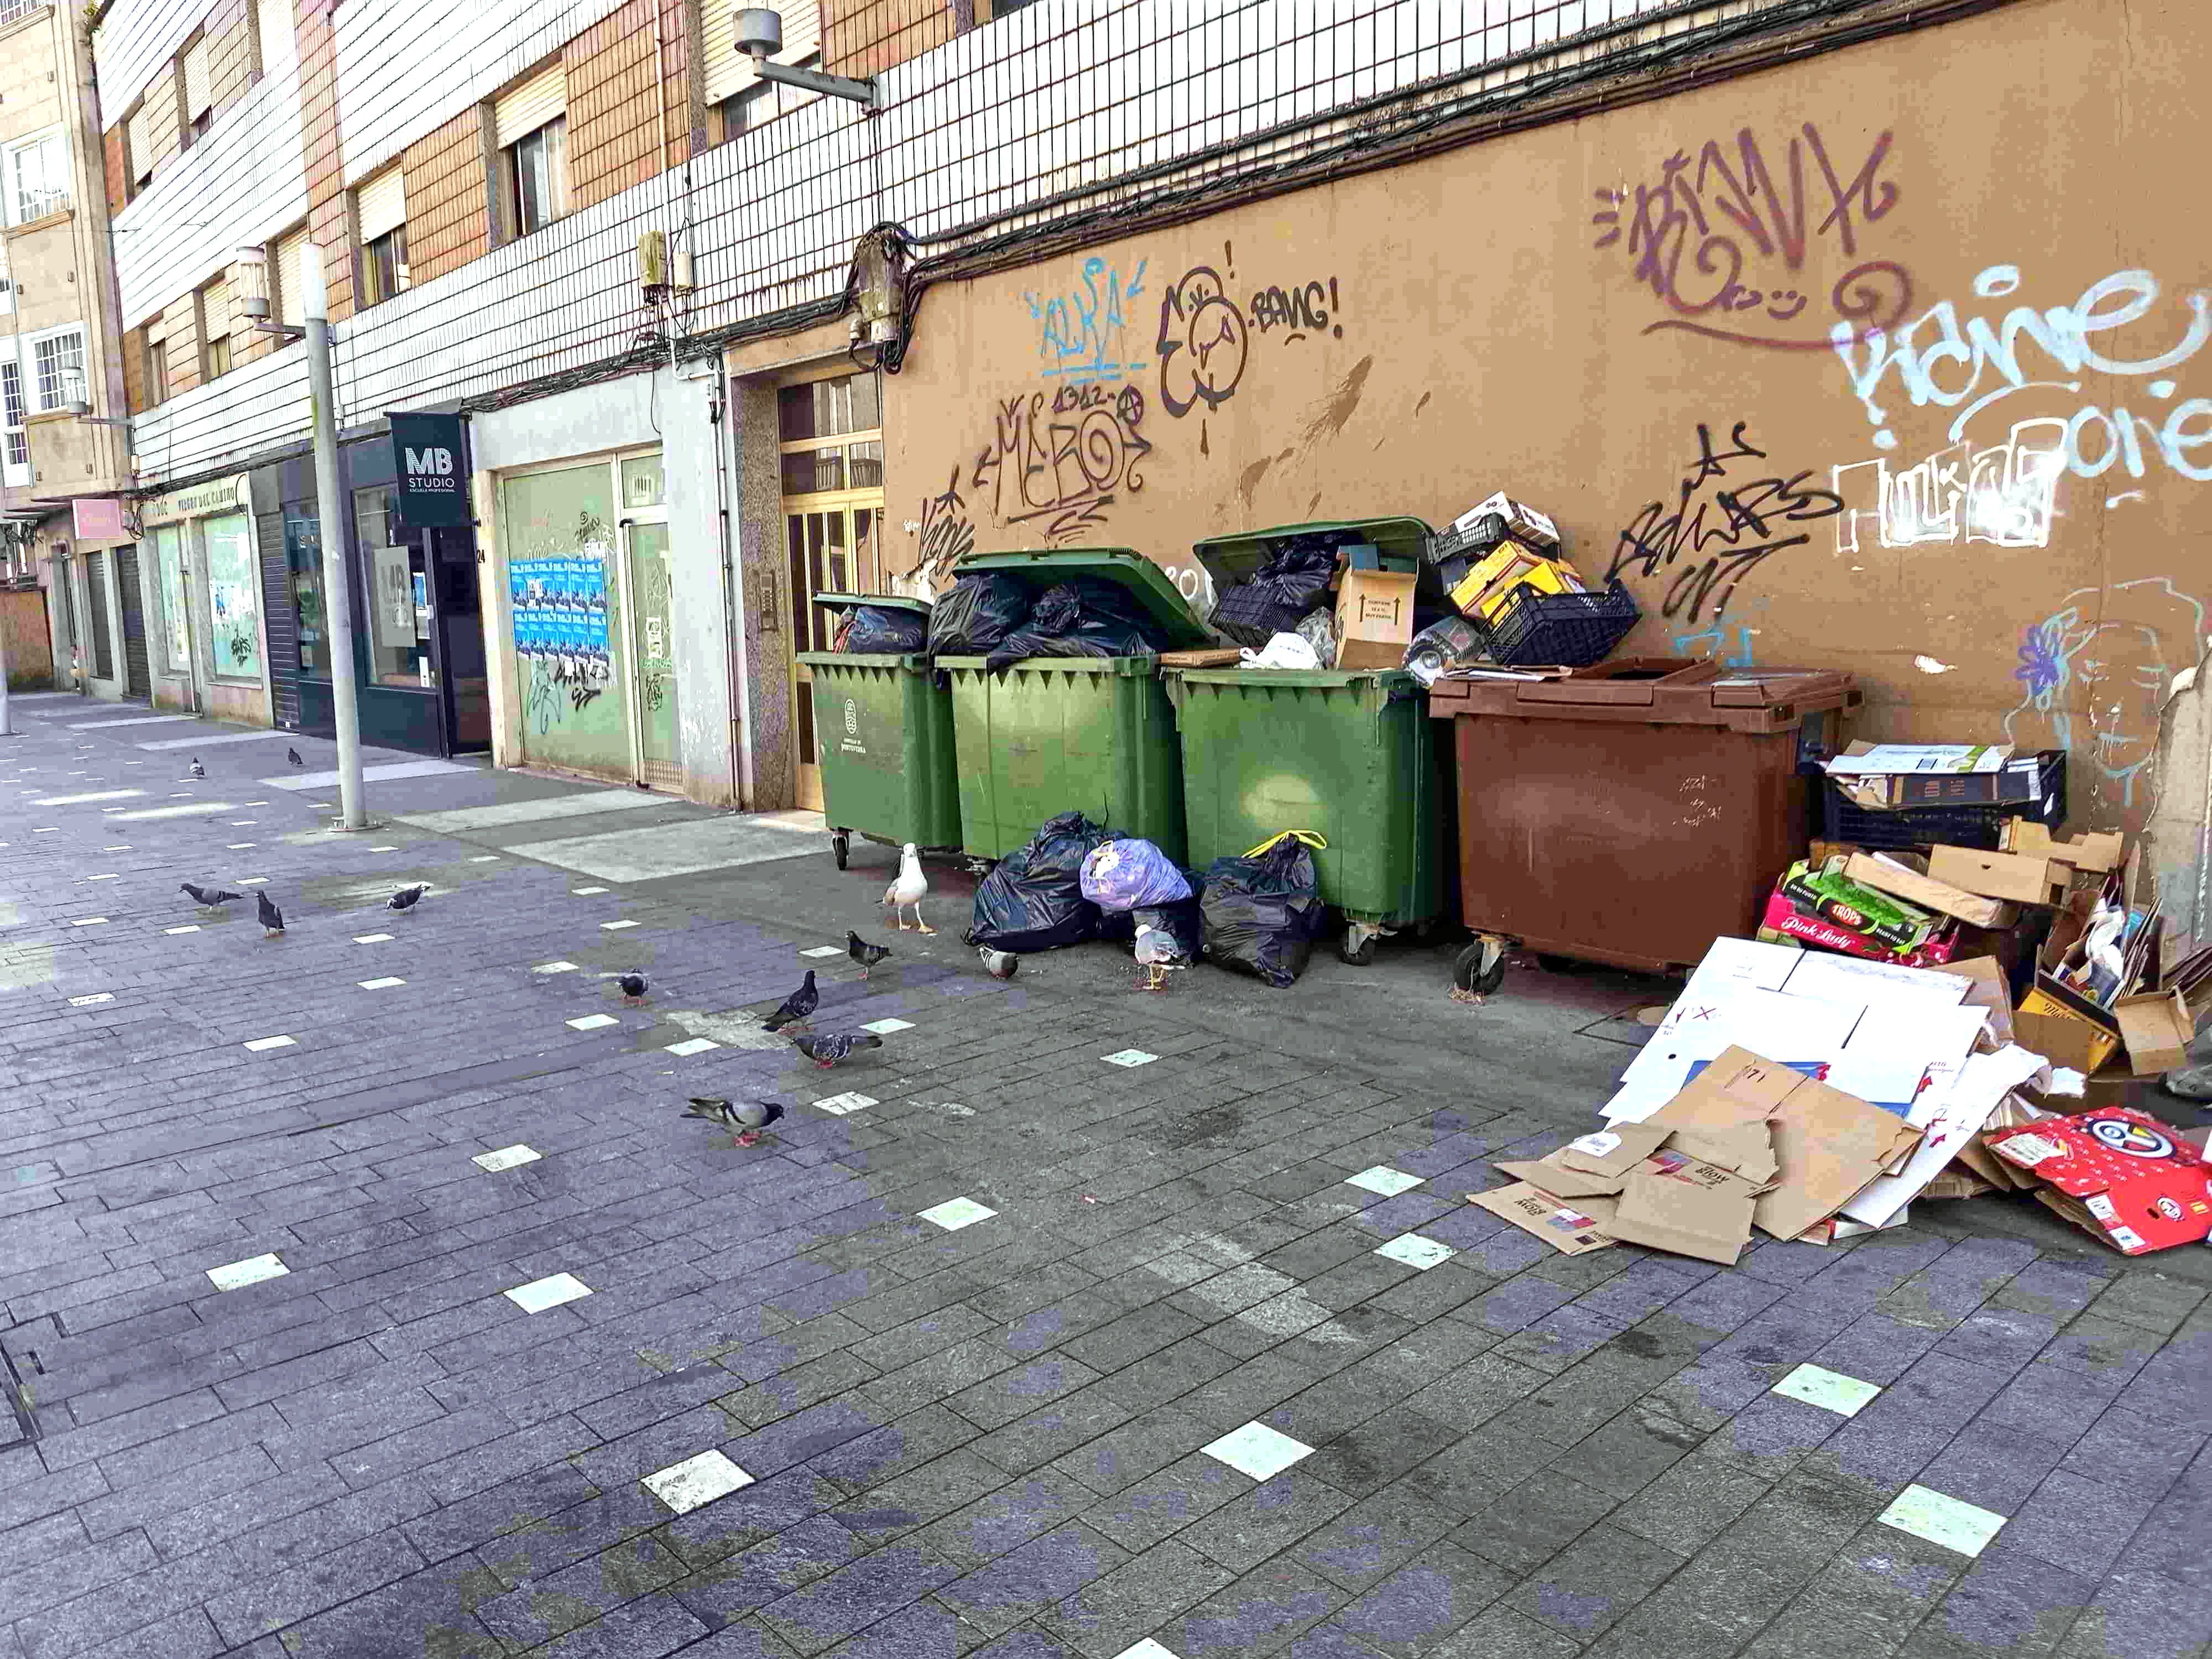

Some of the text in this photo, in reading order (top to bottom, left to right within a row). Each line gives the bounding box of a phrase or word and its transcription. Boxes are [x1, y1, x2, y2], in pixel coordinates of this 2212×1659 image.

[405, 447, 453, 474] MB
[409, 477, 455, 487] STUDIO
[1781, 916, 1851, 948] Pink Lady
